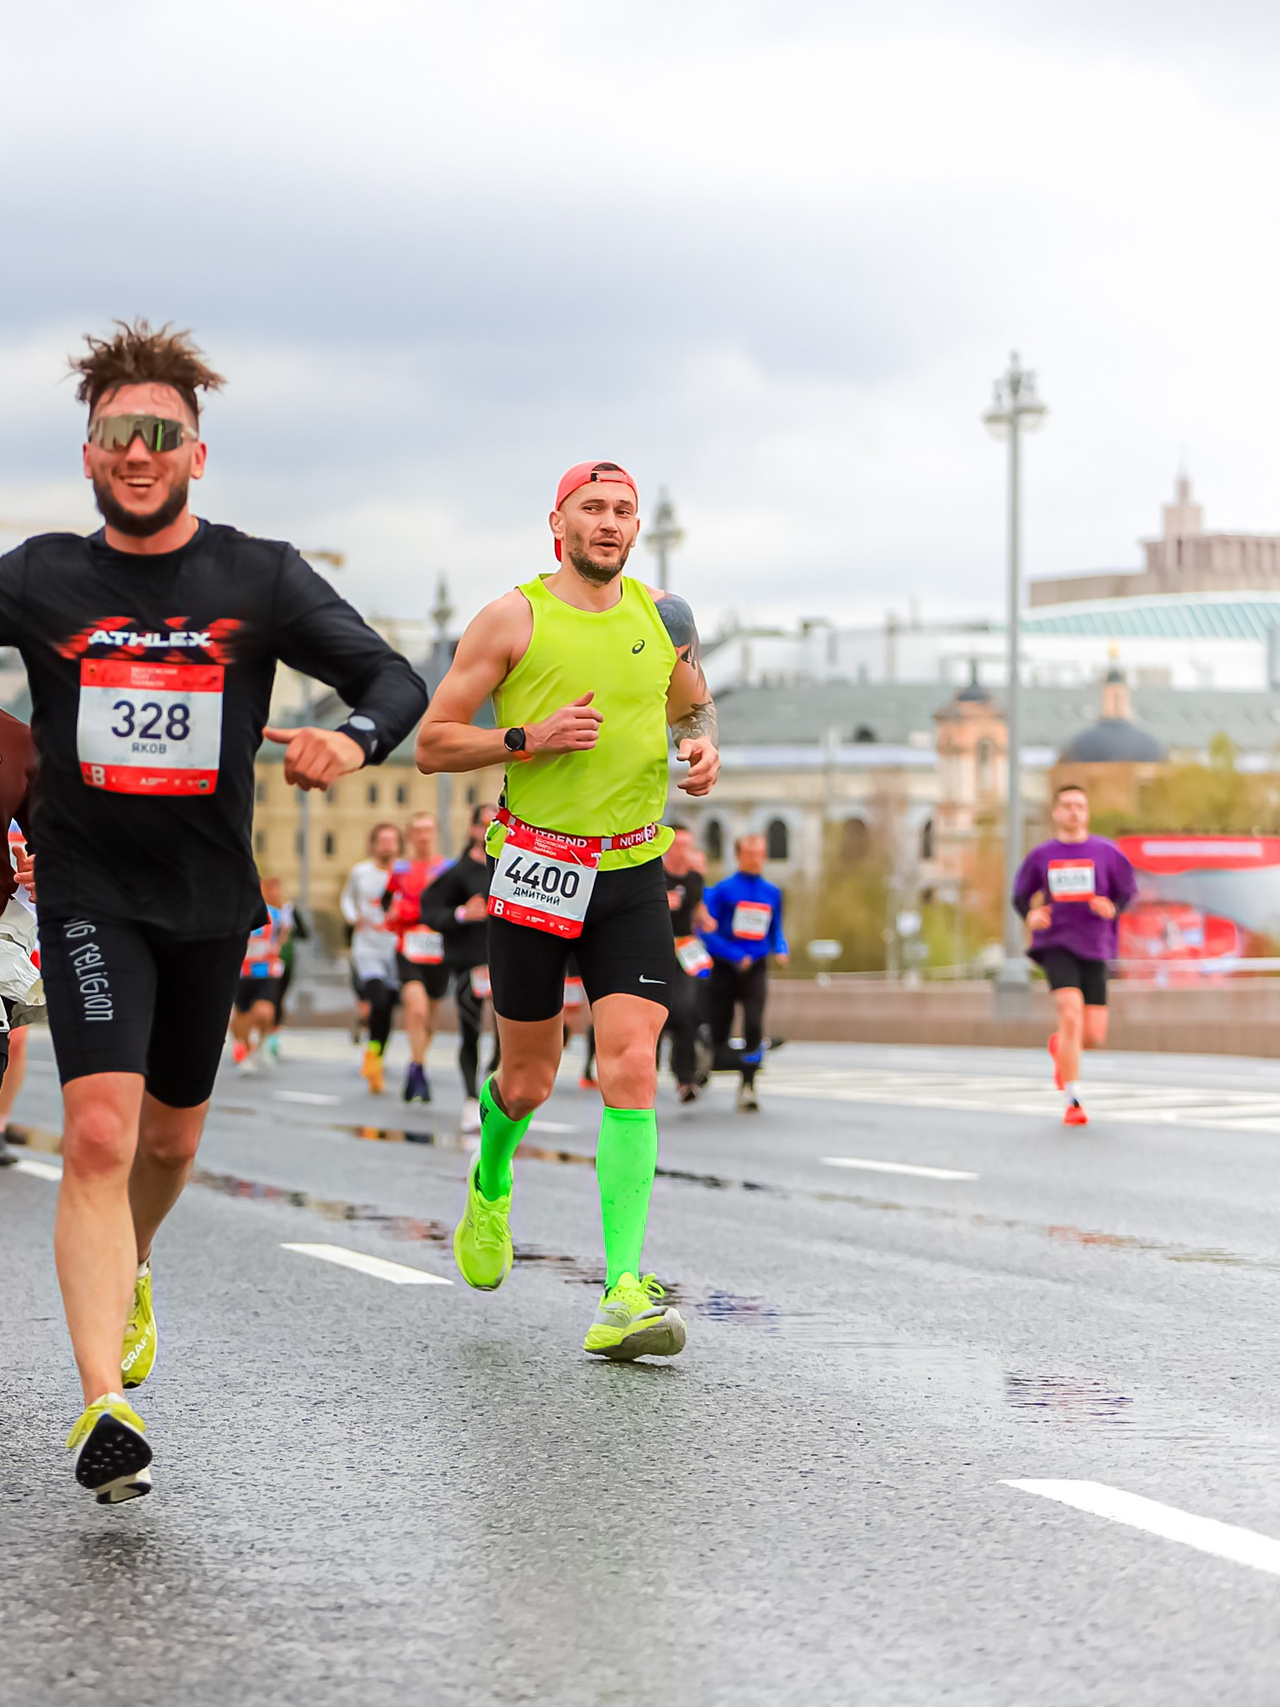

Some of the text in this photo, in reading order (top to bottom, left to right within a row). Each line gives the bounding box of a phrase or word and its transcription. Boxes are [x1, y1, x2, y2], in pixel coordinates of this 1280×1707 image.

[87, 630, 213, 648] ATHLEX
[111, 700, 190, 741] 328
[131, 742, 167, 754] ЯКОВ
[91, 765, 106, 785] B
[505, 856, 580, 899] 4400
[513, 886, 561, 906] ДМИТРИЙ
[493, 900, 505, 916] B
[120, 1325, 152, 1371] CRAFT
